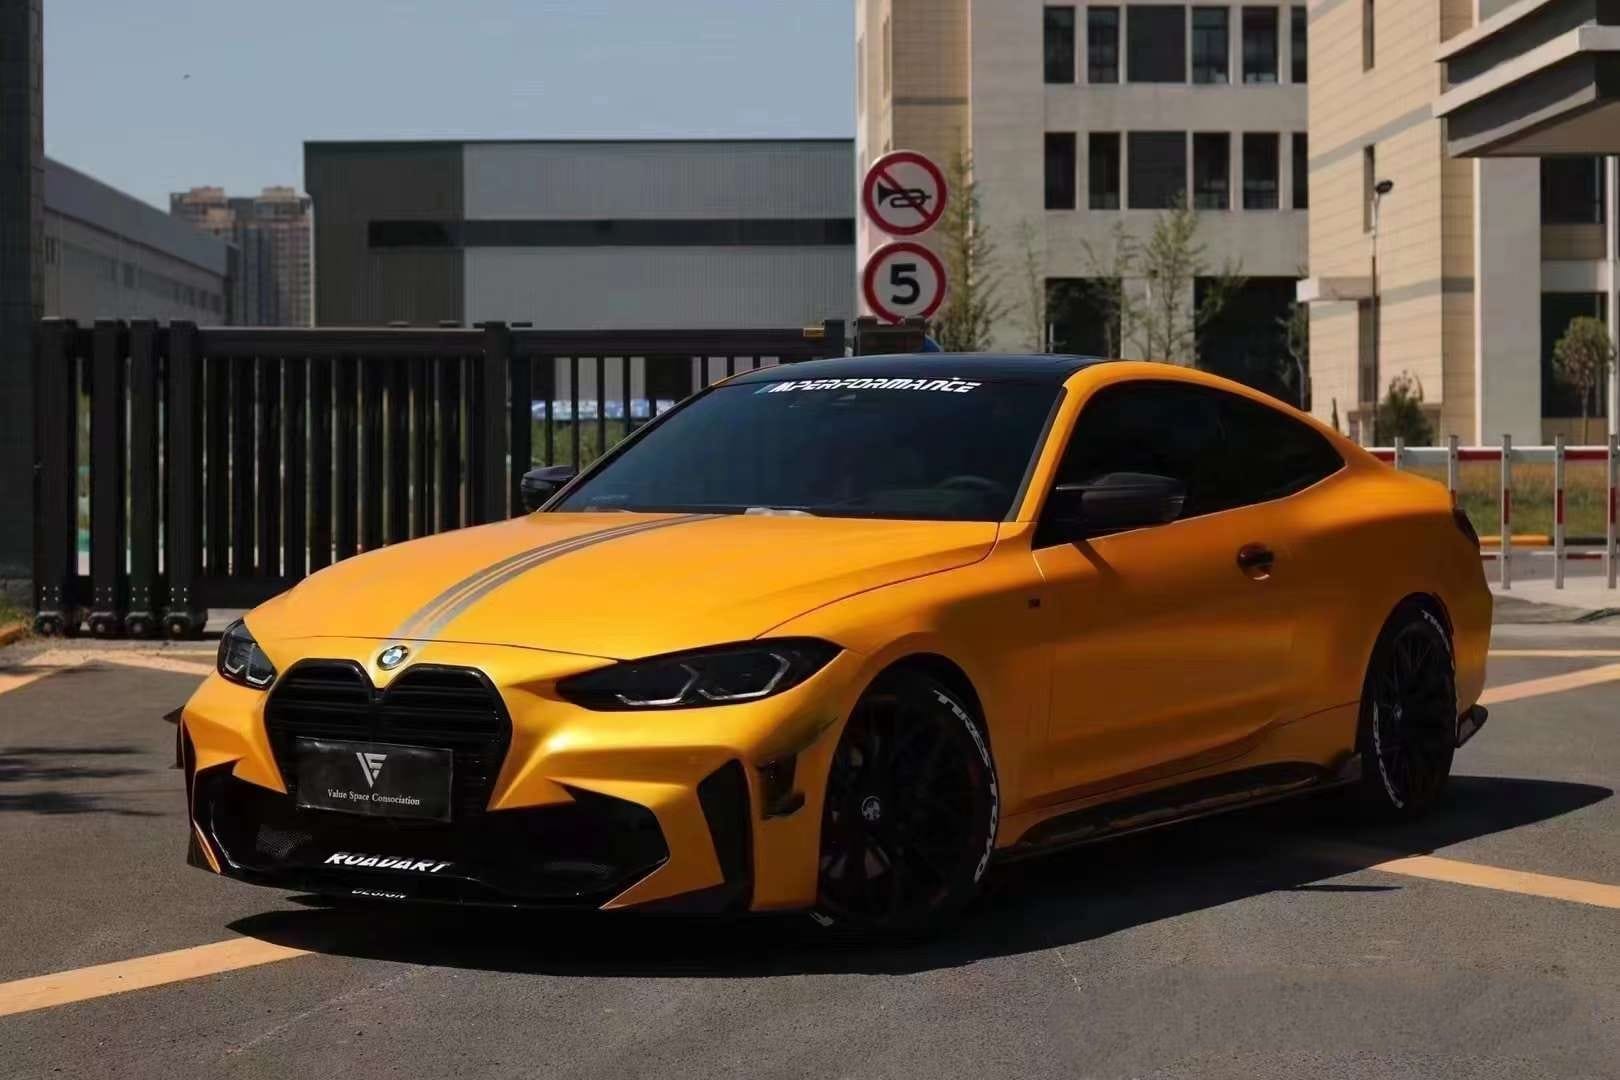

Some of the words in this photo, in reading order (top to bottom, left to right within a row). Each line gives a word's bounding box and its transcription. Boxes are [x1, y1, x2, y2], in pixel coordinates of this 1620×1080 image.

[890, 263, 921, 305] 5
[327, 788, 347, 799] Value
[349, 791, 370, 802] Space
[372, 793, 420, 805] Consociation
